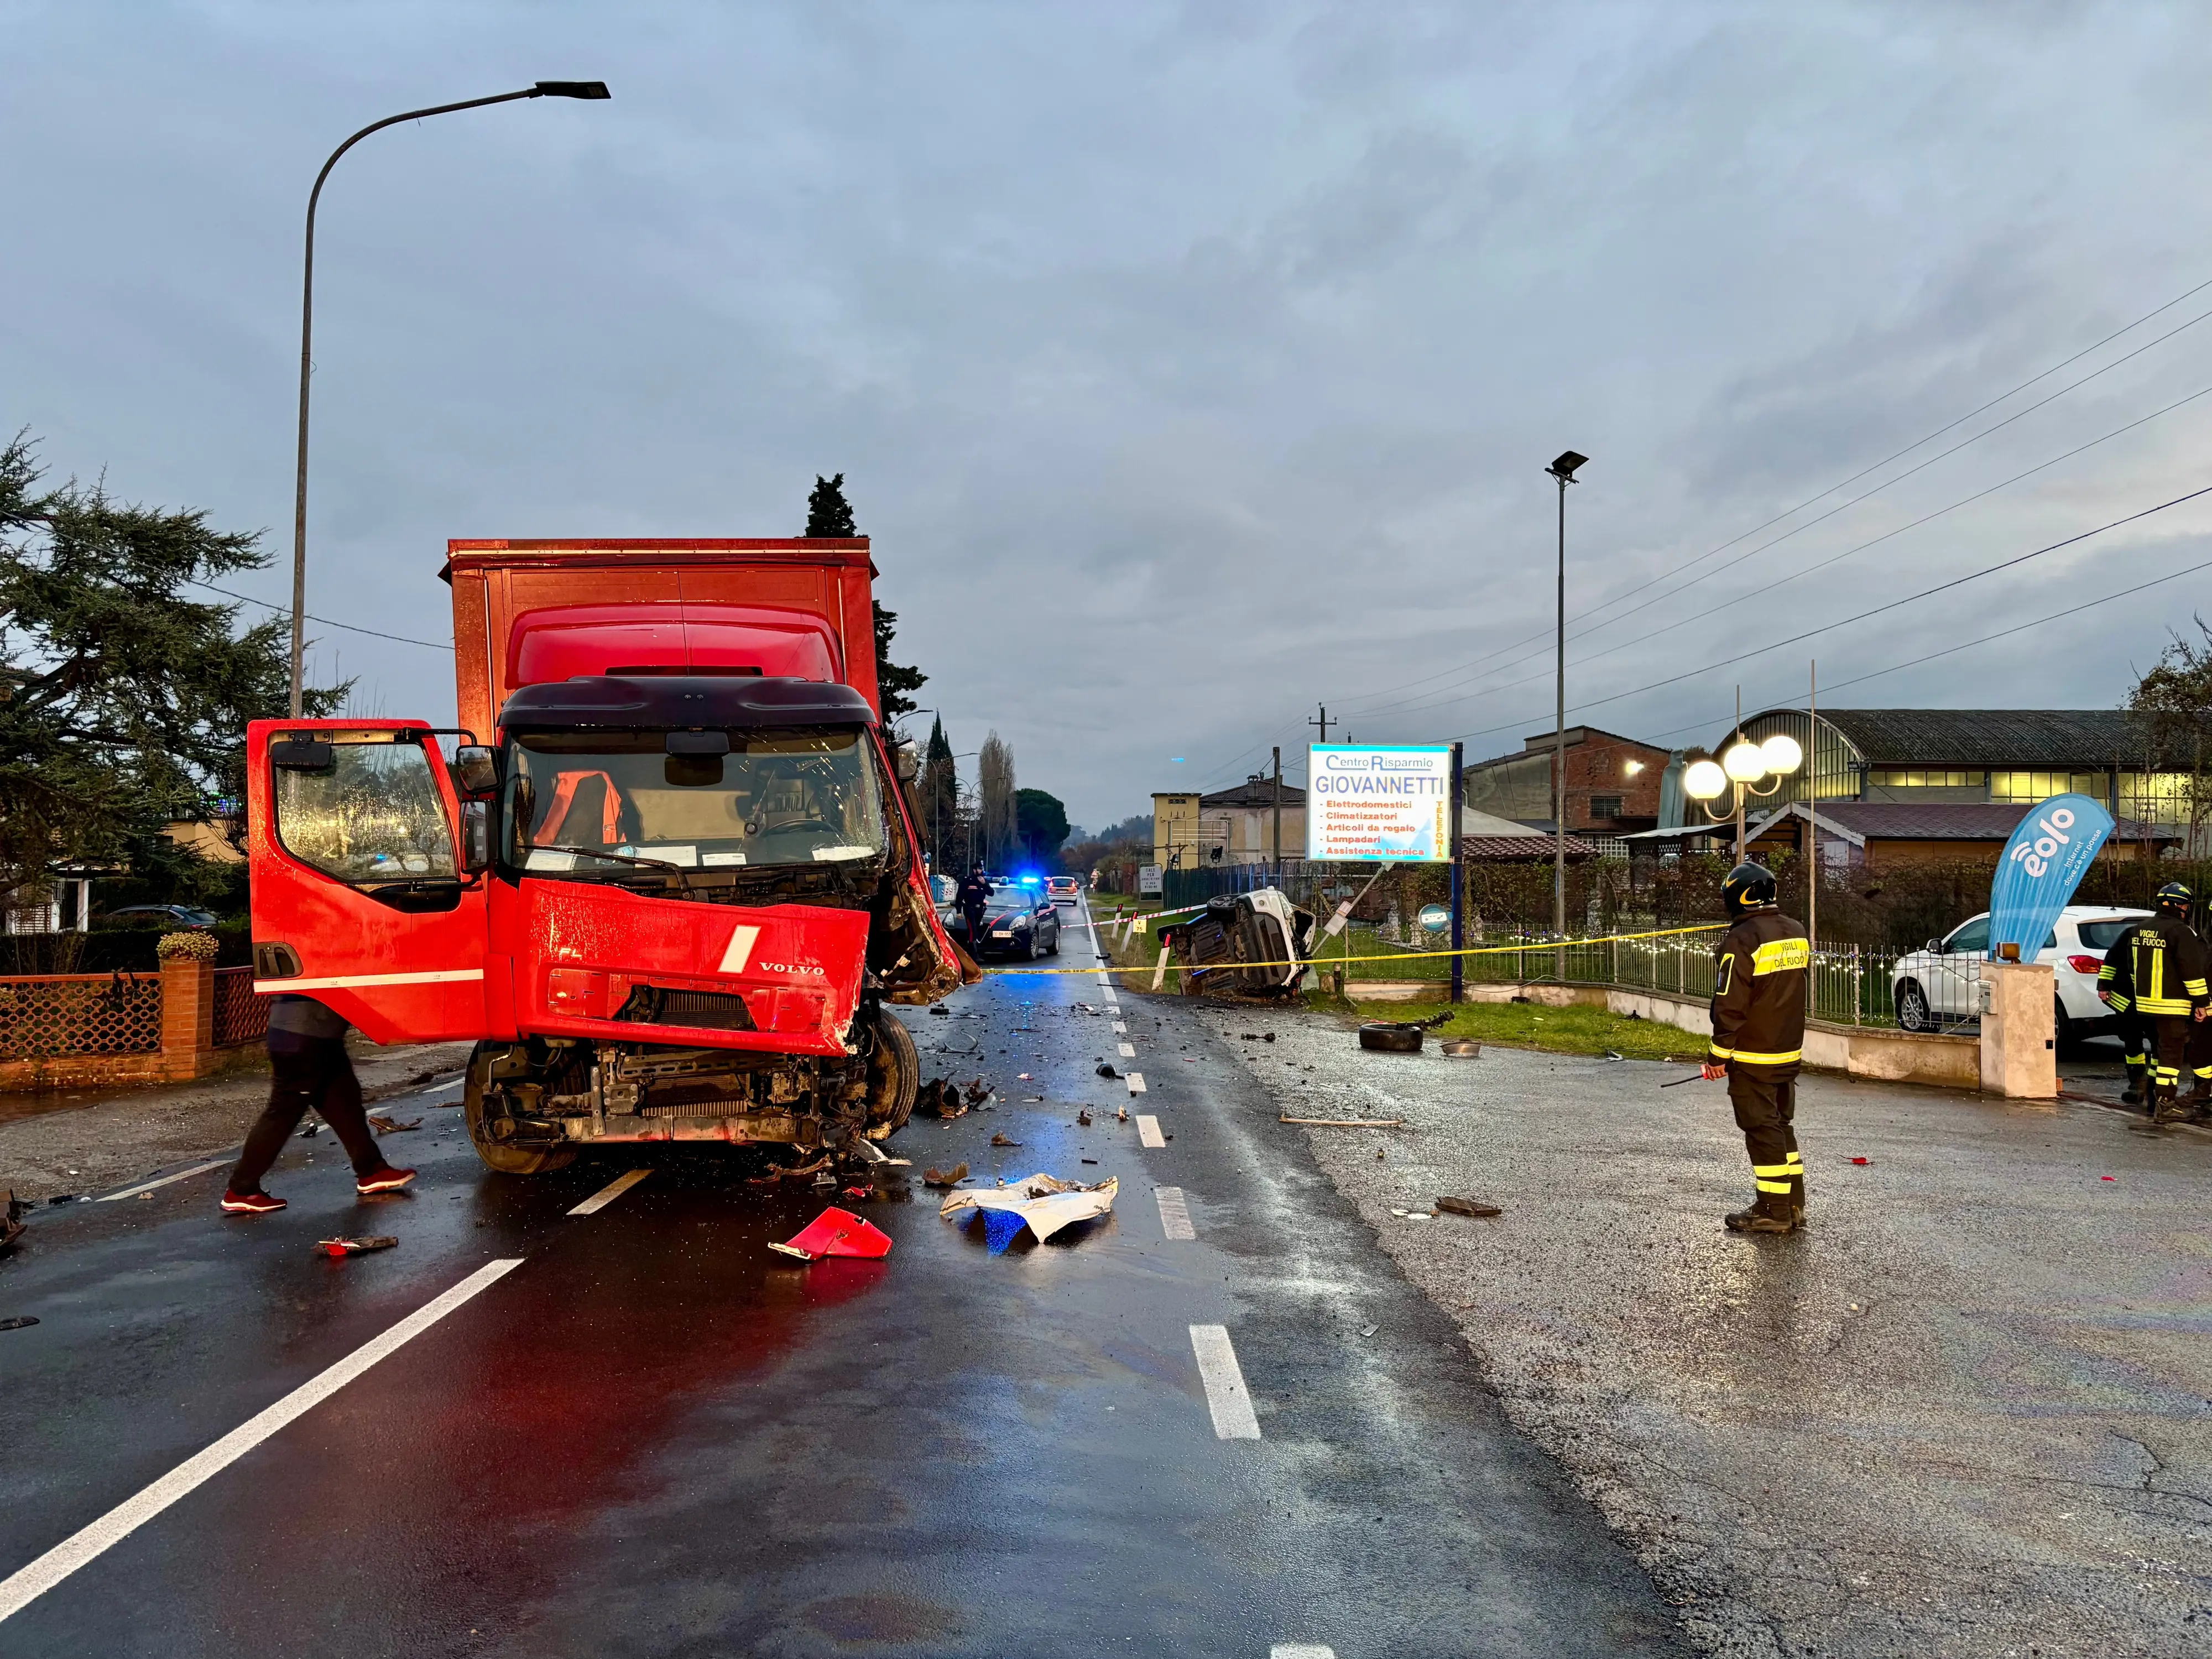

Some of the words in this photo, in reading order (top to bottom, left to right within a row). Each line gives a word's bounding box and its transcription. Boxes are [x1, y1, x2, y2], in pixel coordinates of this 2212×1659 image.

[1326, 754, 1369, 770] Centro
[1371, 755, 1433, 771] Risparmio
[1316, 775, 1443, 795] GIOVANNETTI
[1326, 800, 1412, 808] Elettrodomestici
[1383, 825, 1416, 833] regalo
[1326, 836, 1381, 844] Lampadari
[2025, 808, 2075, 878] eolo
[1326, 847, 1382, 855] Assistenza
[2064, 841, 2084, 867] Internet
[2064, 870, 2077, 885] dove
[2080, 850, 2089, 859] un
[2086, 829, 2102, 851] paese
[2140, 929, 2158, 938] VIGILI
[2142, 937, 2166, 947] FUOCO
[559, 947, 582, 958] FL
[759, 962, 825, 976] VOLVO
